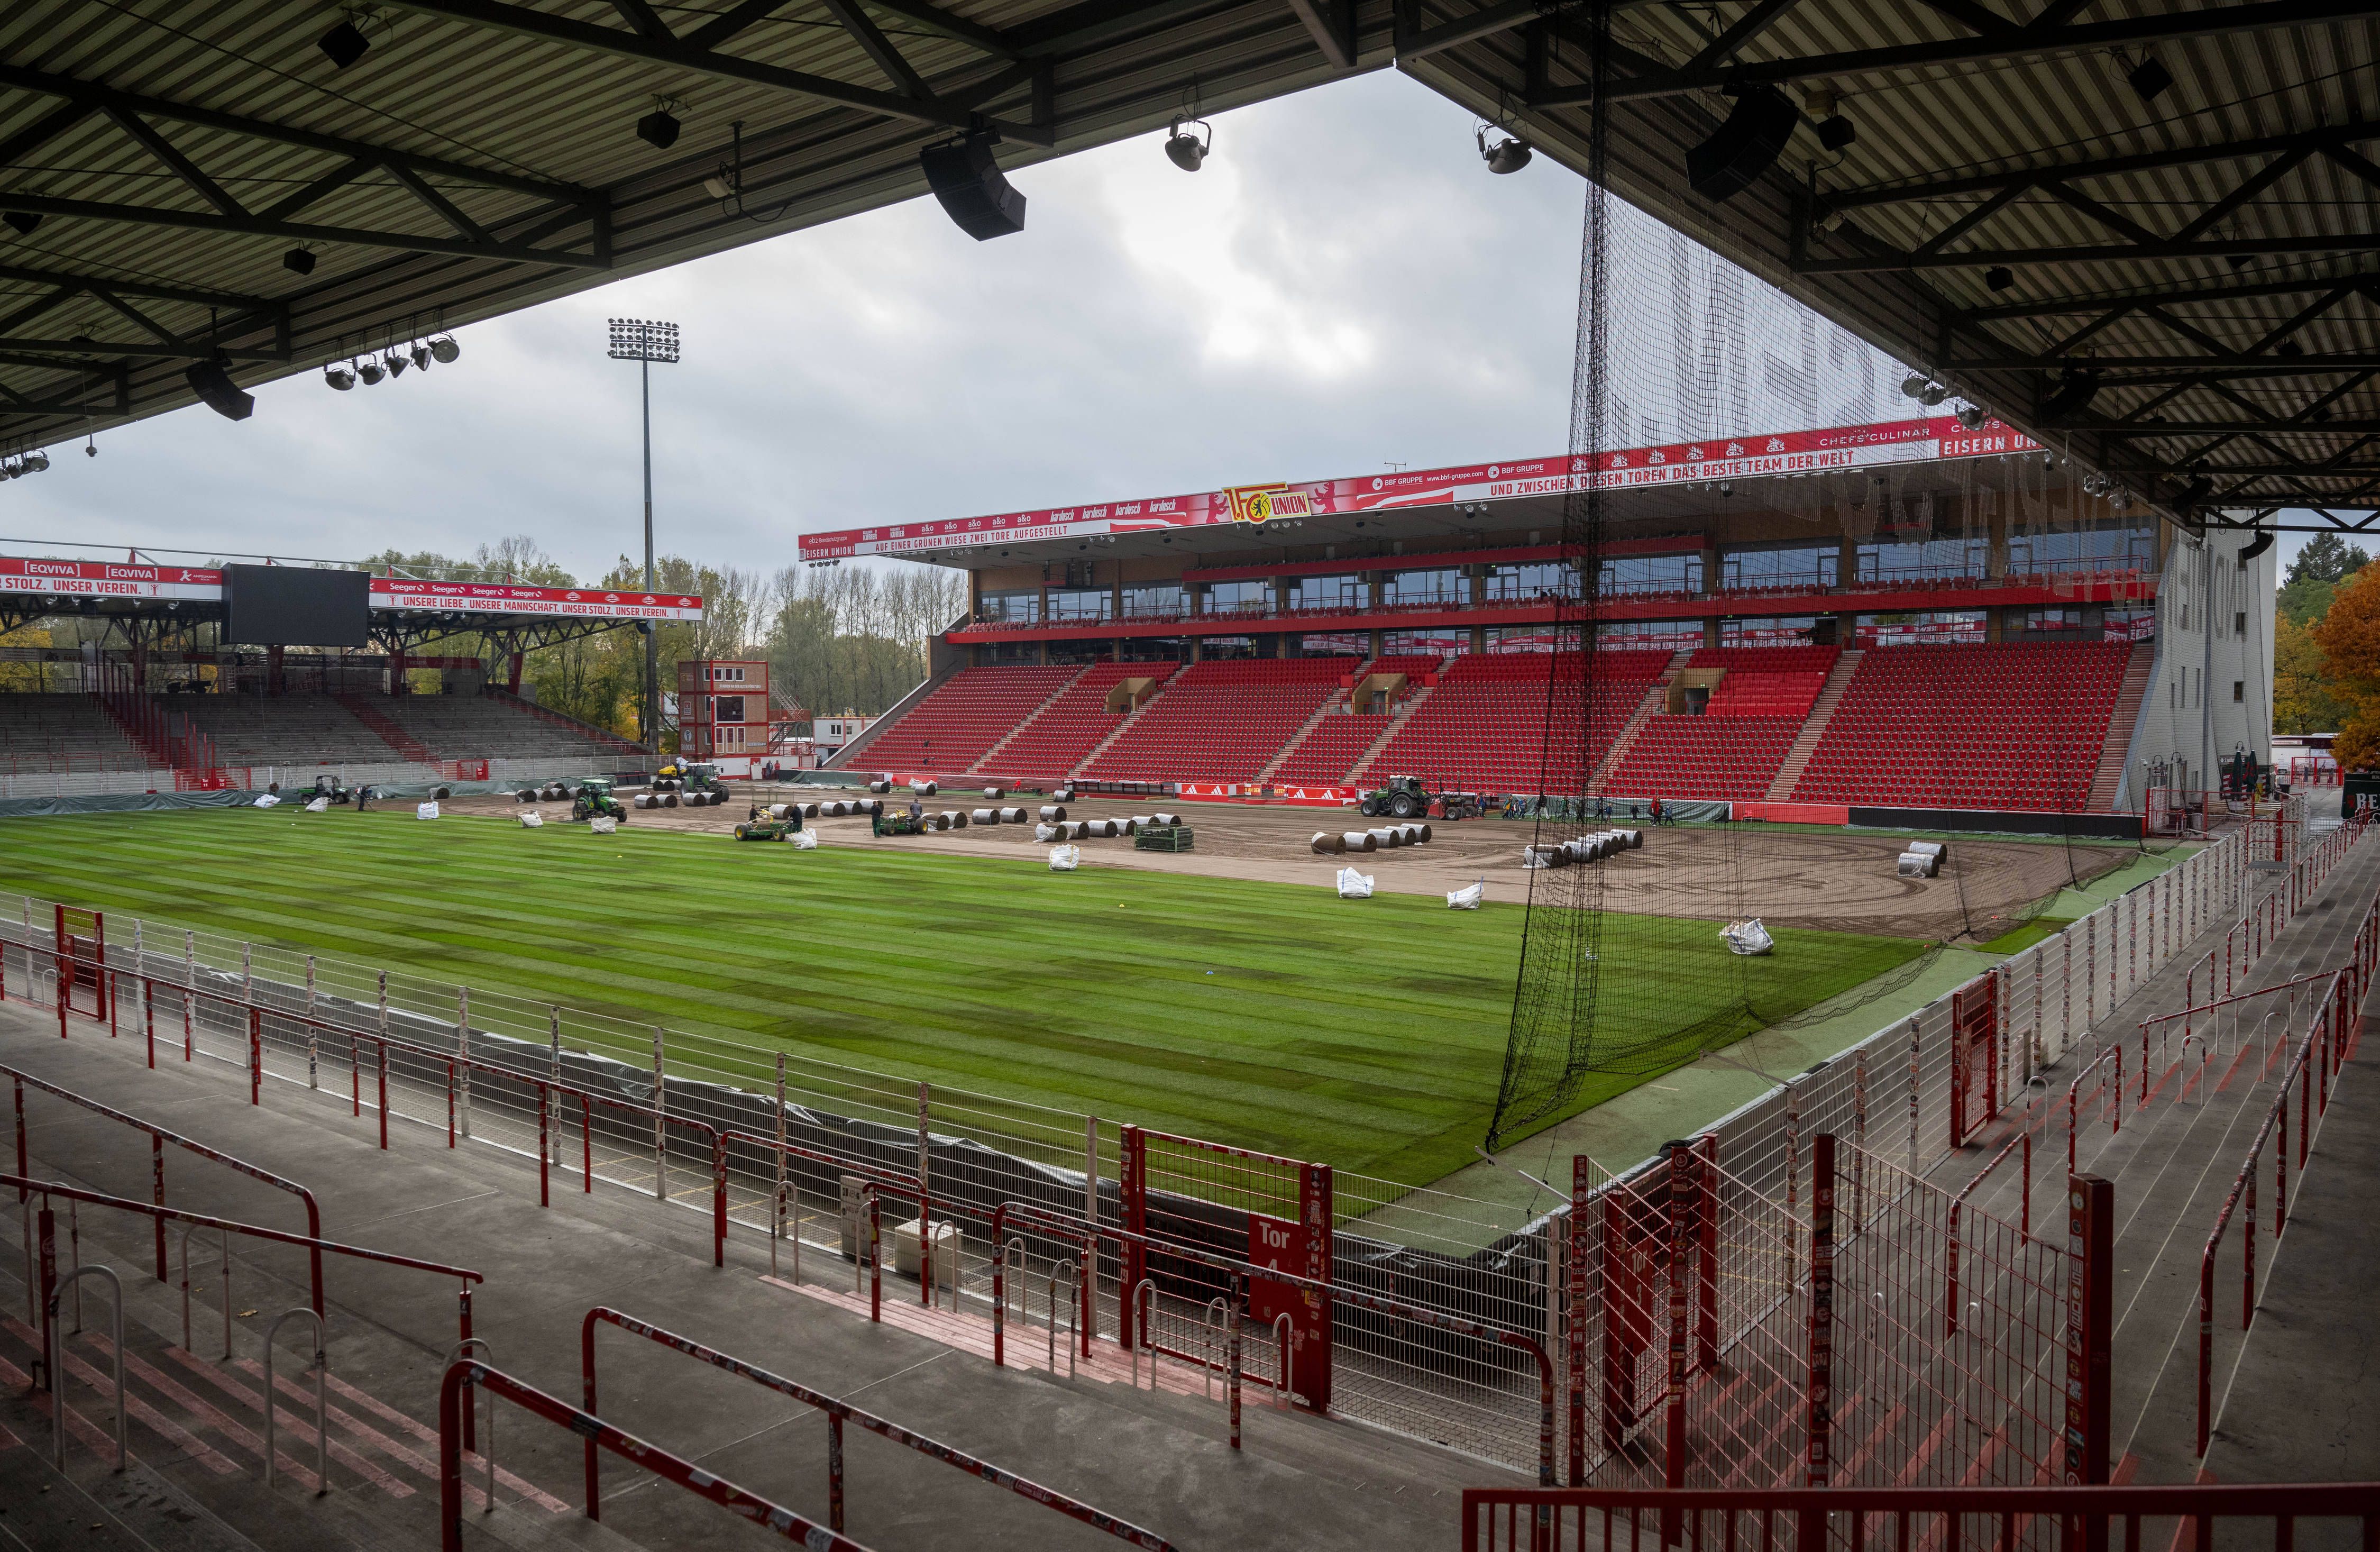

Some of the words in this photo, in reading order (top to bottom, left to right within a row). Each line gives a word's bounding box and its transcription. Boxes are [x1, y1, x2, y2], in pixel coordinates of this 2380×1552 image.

[1944, 436, 2005, 454] EISERN
[2014, 434, 2043, 448] UN
[1490, 483, 1513, 496] UND
[1517, 477, 1575, 494] ZWISCHEN
[1627, 468, 1666, 483] TOREN
[1673, 465, 1697, 480] DAS
[1702, 461, 1741, 477] BESTE
[1746, 457, 1782, 473] TEAM
[1788, 454, 1814, 470] DER
[1818, 450, 1853, 467] WELT
[1516, 463, 1544, 473] GRUPPE
[1398, 476, 1423, 485] GRUPPE
[1427, 470, 1484, 482] www.bbf-gruppe.com
[1082, 505, 1107, 519] bardusch
[1115, 501, 1141, 516] bardusch
[1149, 497, 1176, 513] bardusch
[1273, 495, 1307, 515] UNION
[992, 517, 1005, 525] a&o
[1017, 514, 1031, 523] a&o
[1050, 509, 1074, 523] bardusch
[875, 543, 888, 552] AUF
[891, 541, 911, 551] EINER
[914, 537, 942, 548] GRÜNEN
[945, 535, 967, 545] WIESE
[970, 533, 987, 543] ZWEI
[991, 530, 1010, 541] TORE
[1014, 525, 1067, 539] AUFGESTELLT
[806, 548, 829, 559] EISERN
[831, 545, 855, 556] UNION!
[5, 577, 47, 591] STOLZ.
[53, 579, 93, 593] UNSER
[97, 582, 142, 595] VEREIN.
[390, 582, 417, 592] Seeger
[432, 585, 458, 594] Seeger
[472, 587, 498, 596] Seeger
[511, 589, 535, 599] Seeger
[403, 596, 437, 608] UNSERE
[440, 598, 466, 609] LIEBE.
[469, 600, 501, 610] UNSERE
[504, 601, 560, 613] MANNSCHAFT.
[562, 605, 587, 614] UNSER
[589, 606, 613, 615] STOLZ.
[616, 607, 639, 616] UNSER
[642, 608, 669, 617] VEREIN.
[2356, 793, 2380, 809] BE
[1259, 1221, 1290, 1249] Tor
[1632, 1249, 1648, 1275] Tor
[1636, 1283, 1642, 1307] 3
